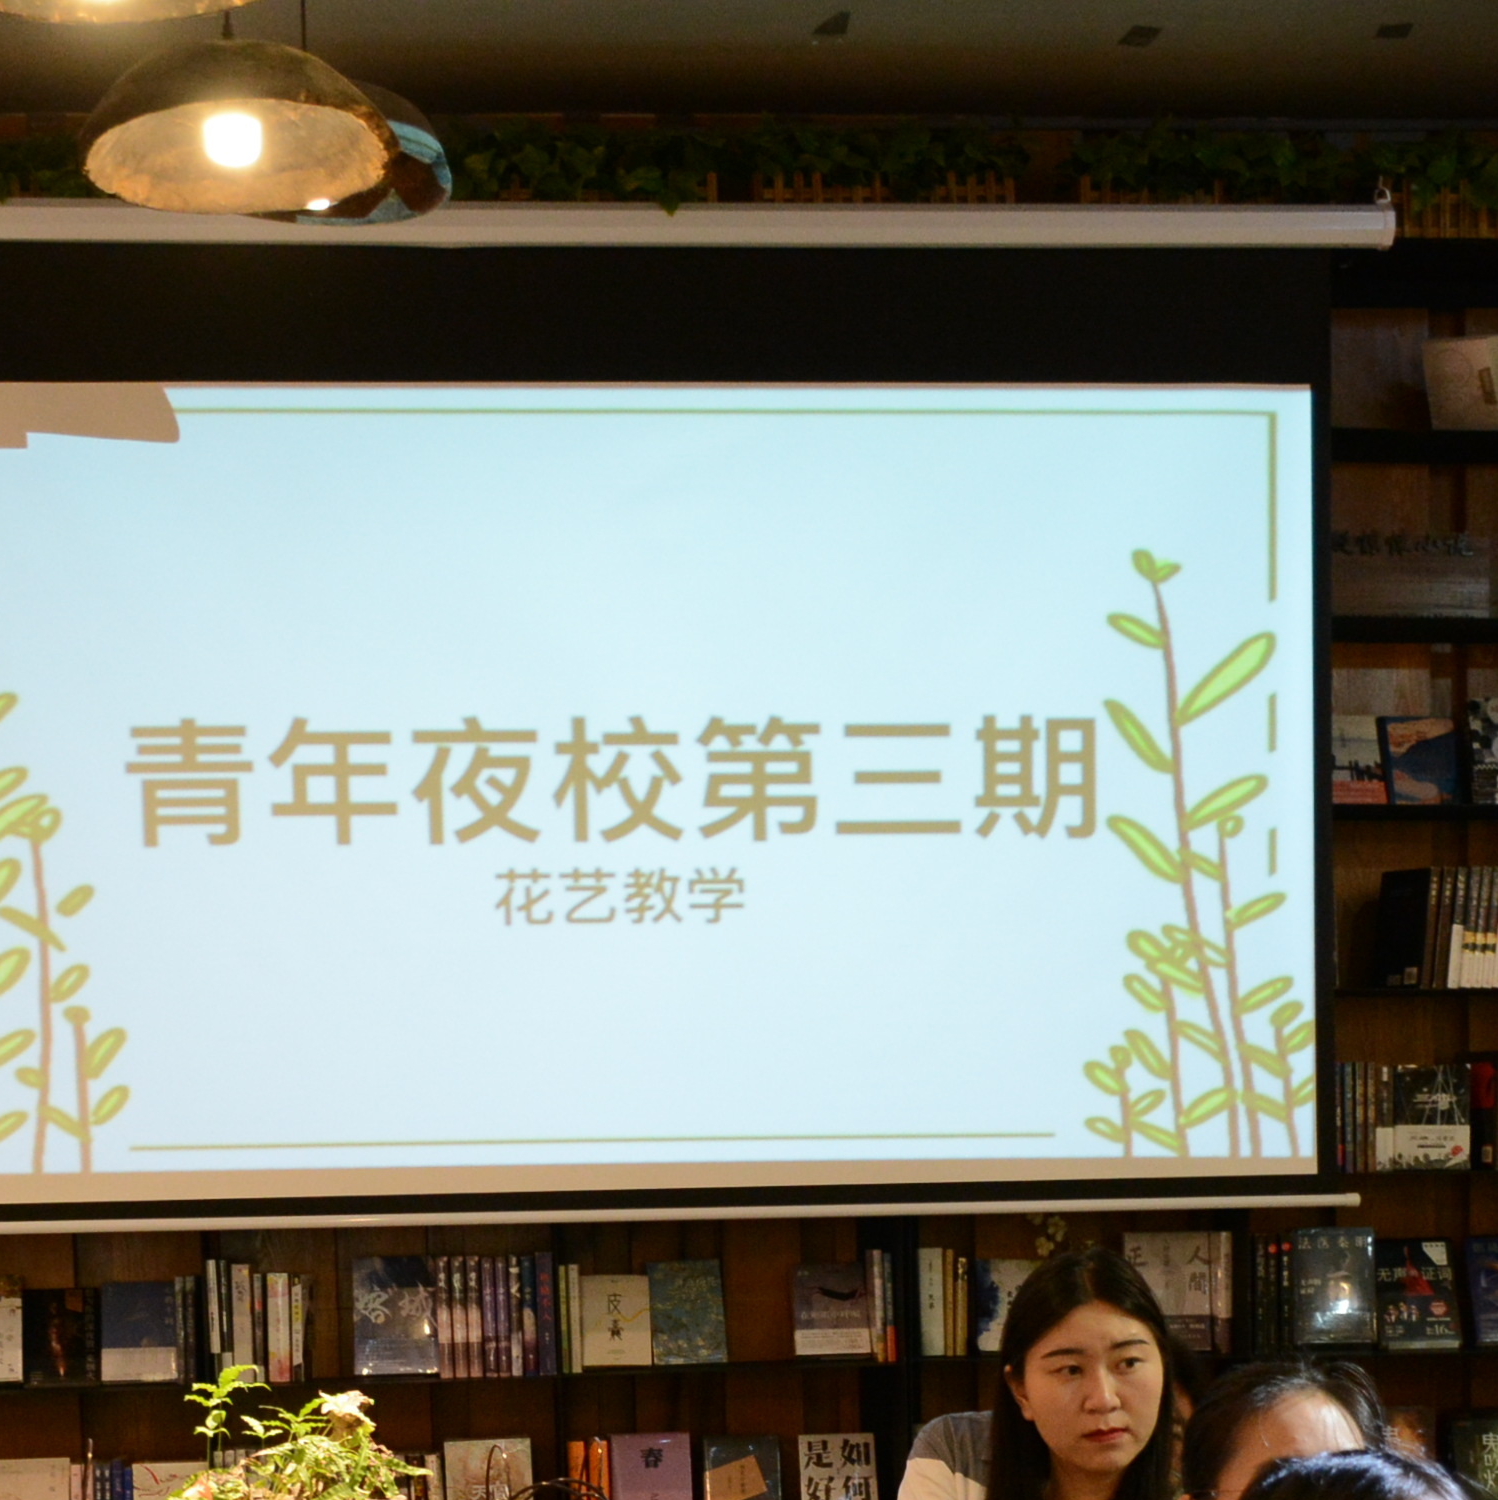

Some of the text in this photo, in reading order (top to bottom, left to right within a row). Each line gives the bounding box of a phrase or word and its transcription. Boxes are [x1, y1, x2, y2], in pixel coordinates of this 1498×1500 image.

[123, 713, 1101, 849] 青年夜校第三期
[492, 866, 747, 926] 花艺教学
[606, 1293, 624, 1342] 皮囊
[640, 1447, 664, 1469] 春
